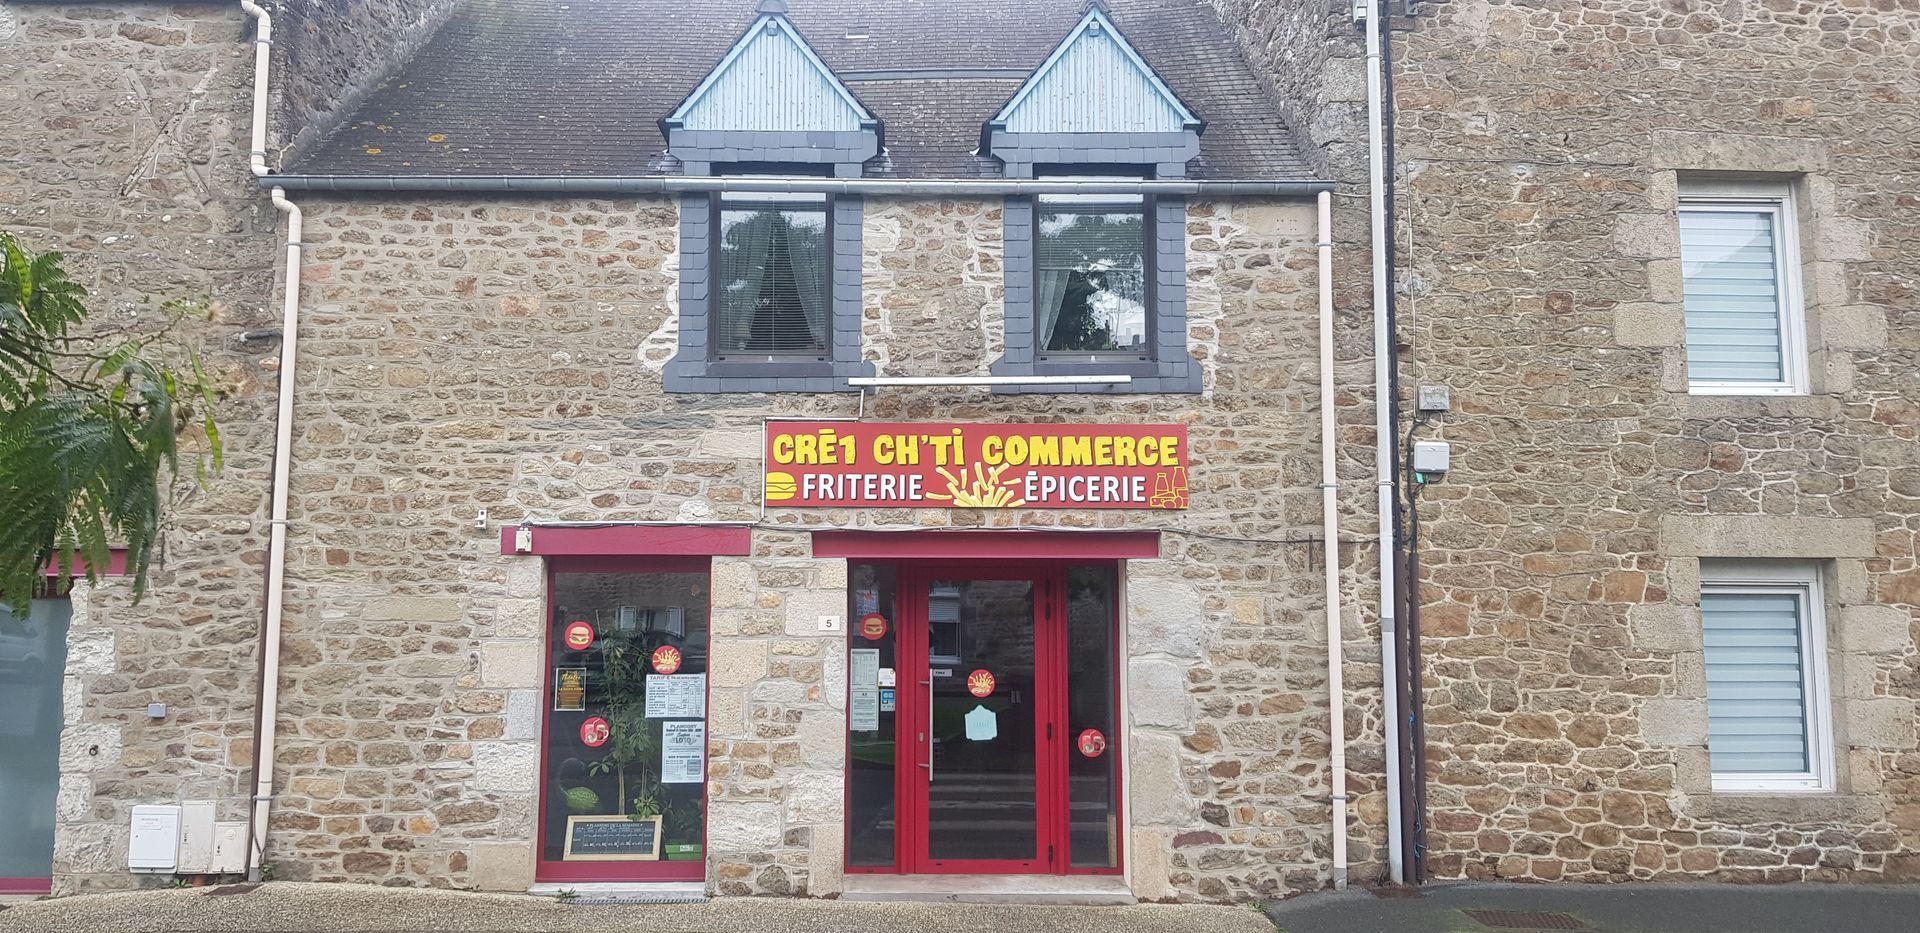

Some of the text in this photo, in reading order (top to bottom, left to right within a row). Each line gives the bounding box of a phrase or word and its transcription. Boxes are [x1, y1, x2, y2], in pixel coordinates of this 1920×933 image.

[982, 435, 1179, 466] COMMERCE
[803, 471, 1146, 502] FRITERIE ÉPICERIE
[826, 619, 832, 628] 5
